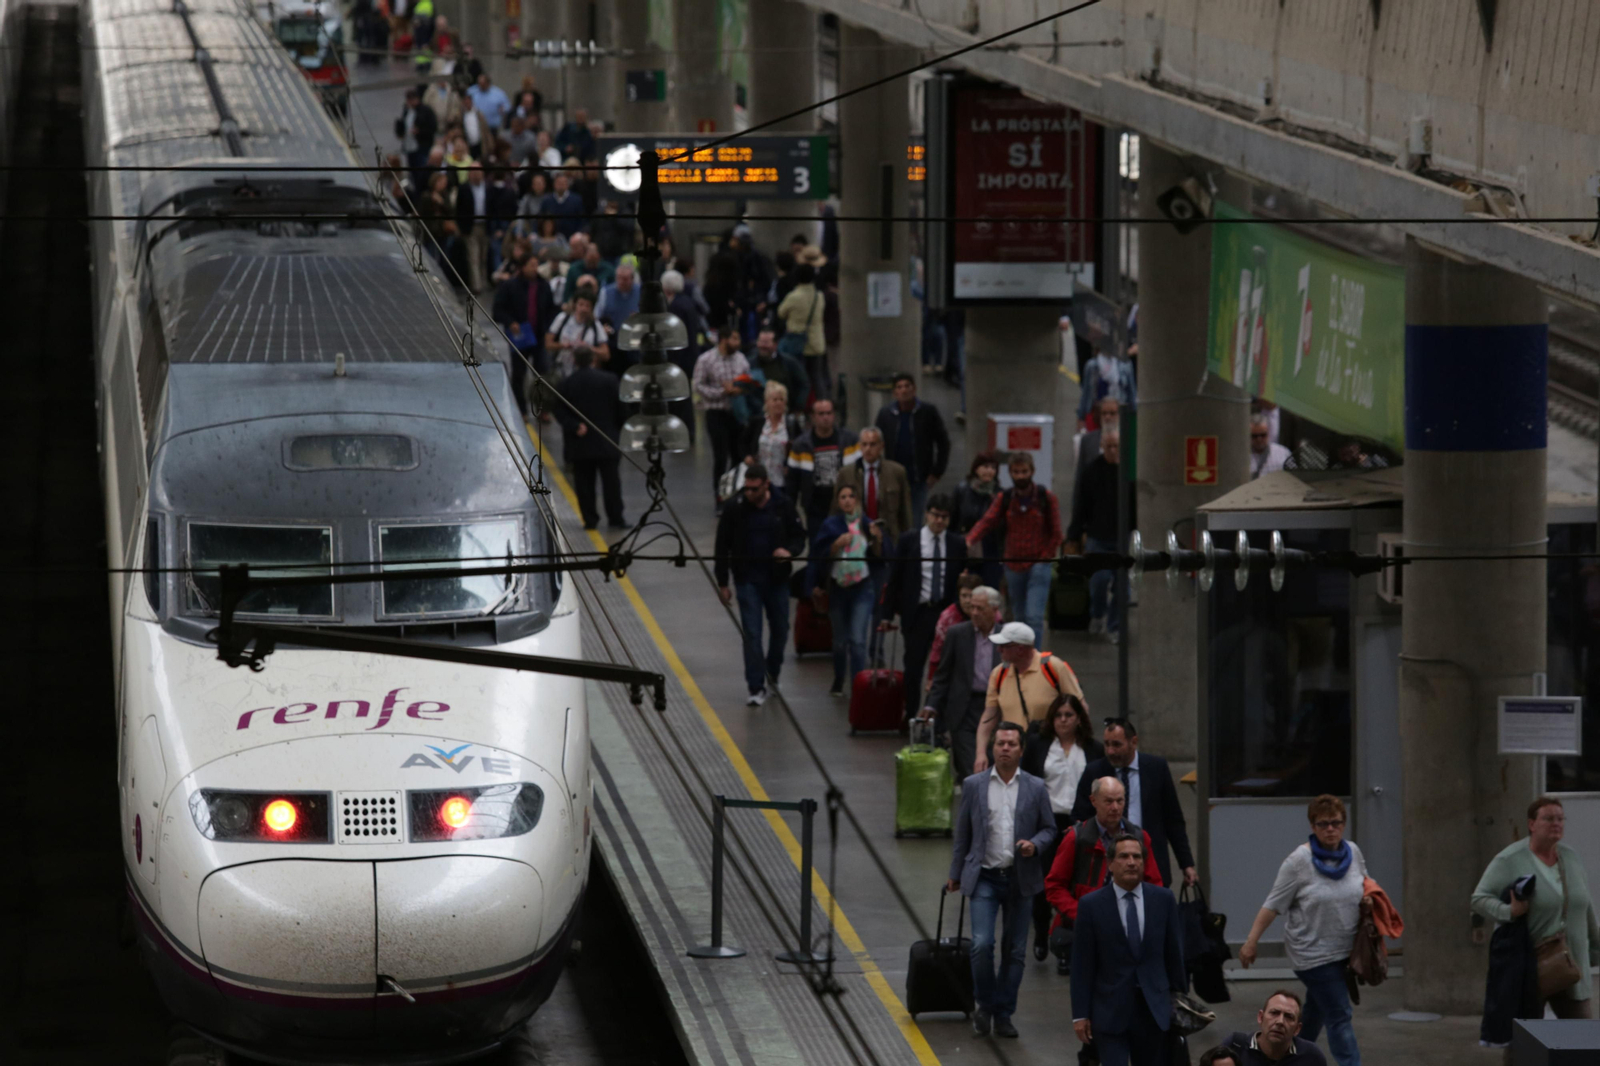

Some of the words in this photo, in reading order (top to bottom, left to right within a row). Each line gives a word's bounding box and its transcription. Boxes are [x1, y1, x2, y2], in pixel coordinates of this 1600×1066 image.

[971, 118, 991, 132] LA
[997, 114, 1080, 132] PRÓSTATA
[1008, 135, 1043, 168] SÍ
[793, 167, 810, 194] 3
[978, 173, 1074, 189] IMPORTA
[236, 687, 451, 731] renfe
[400, 744, 513, 776] AVE
